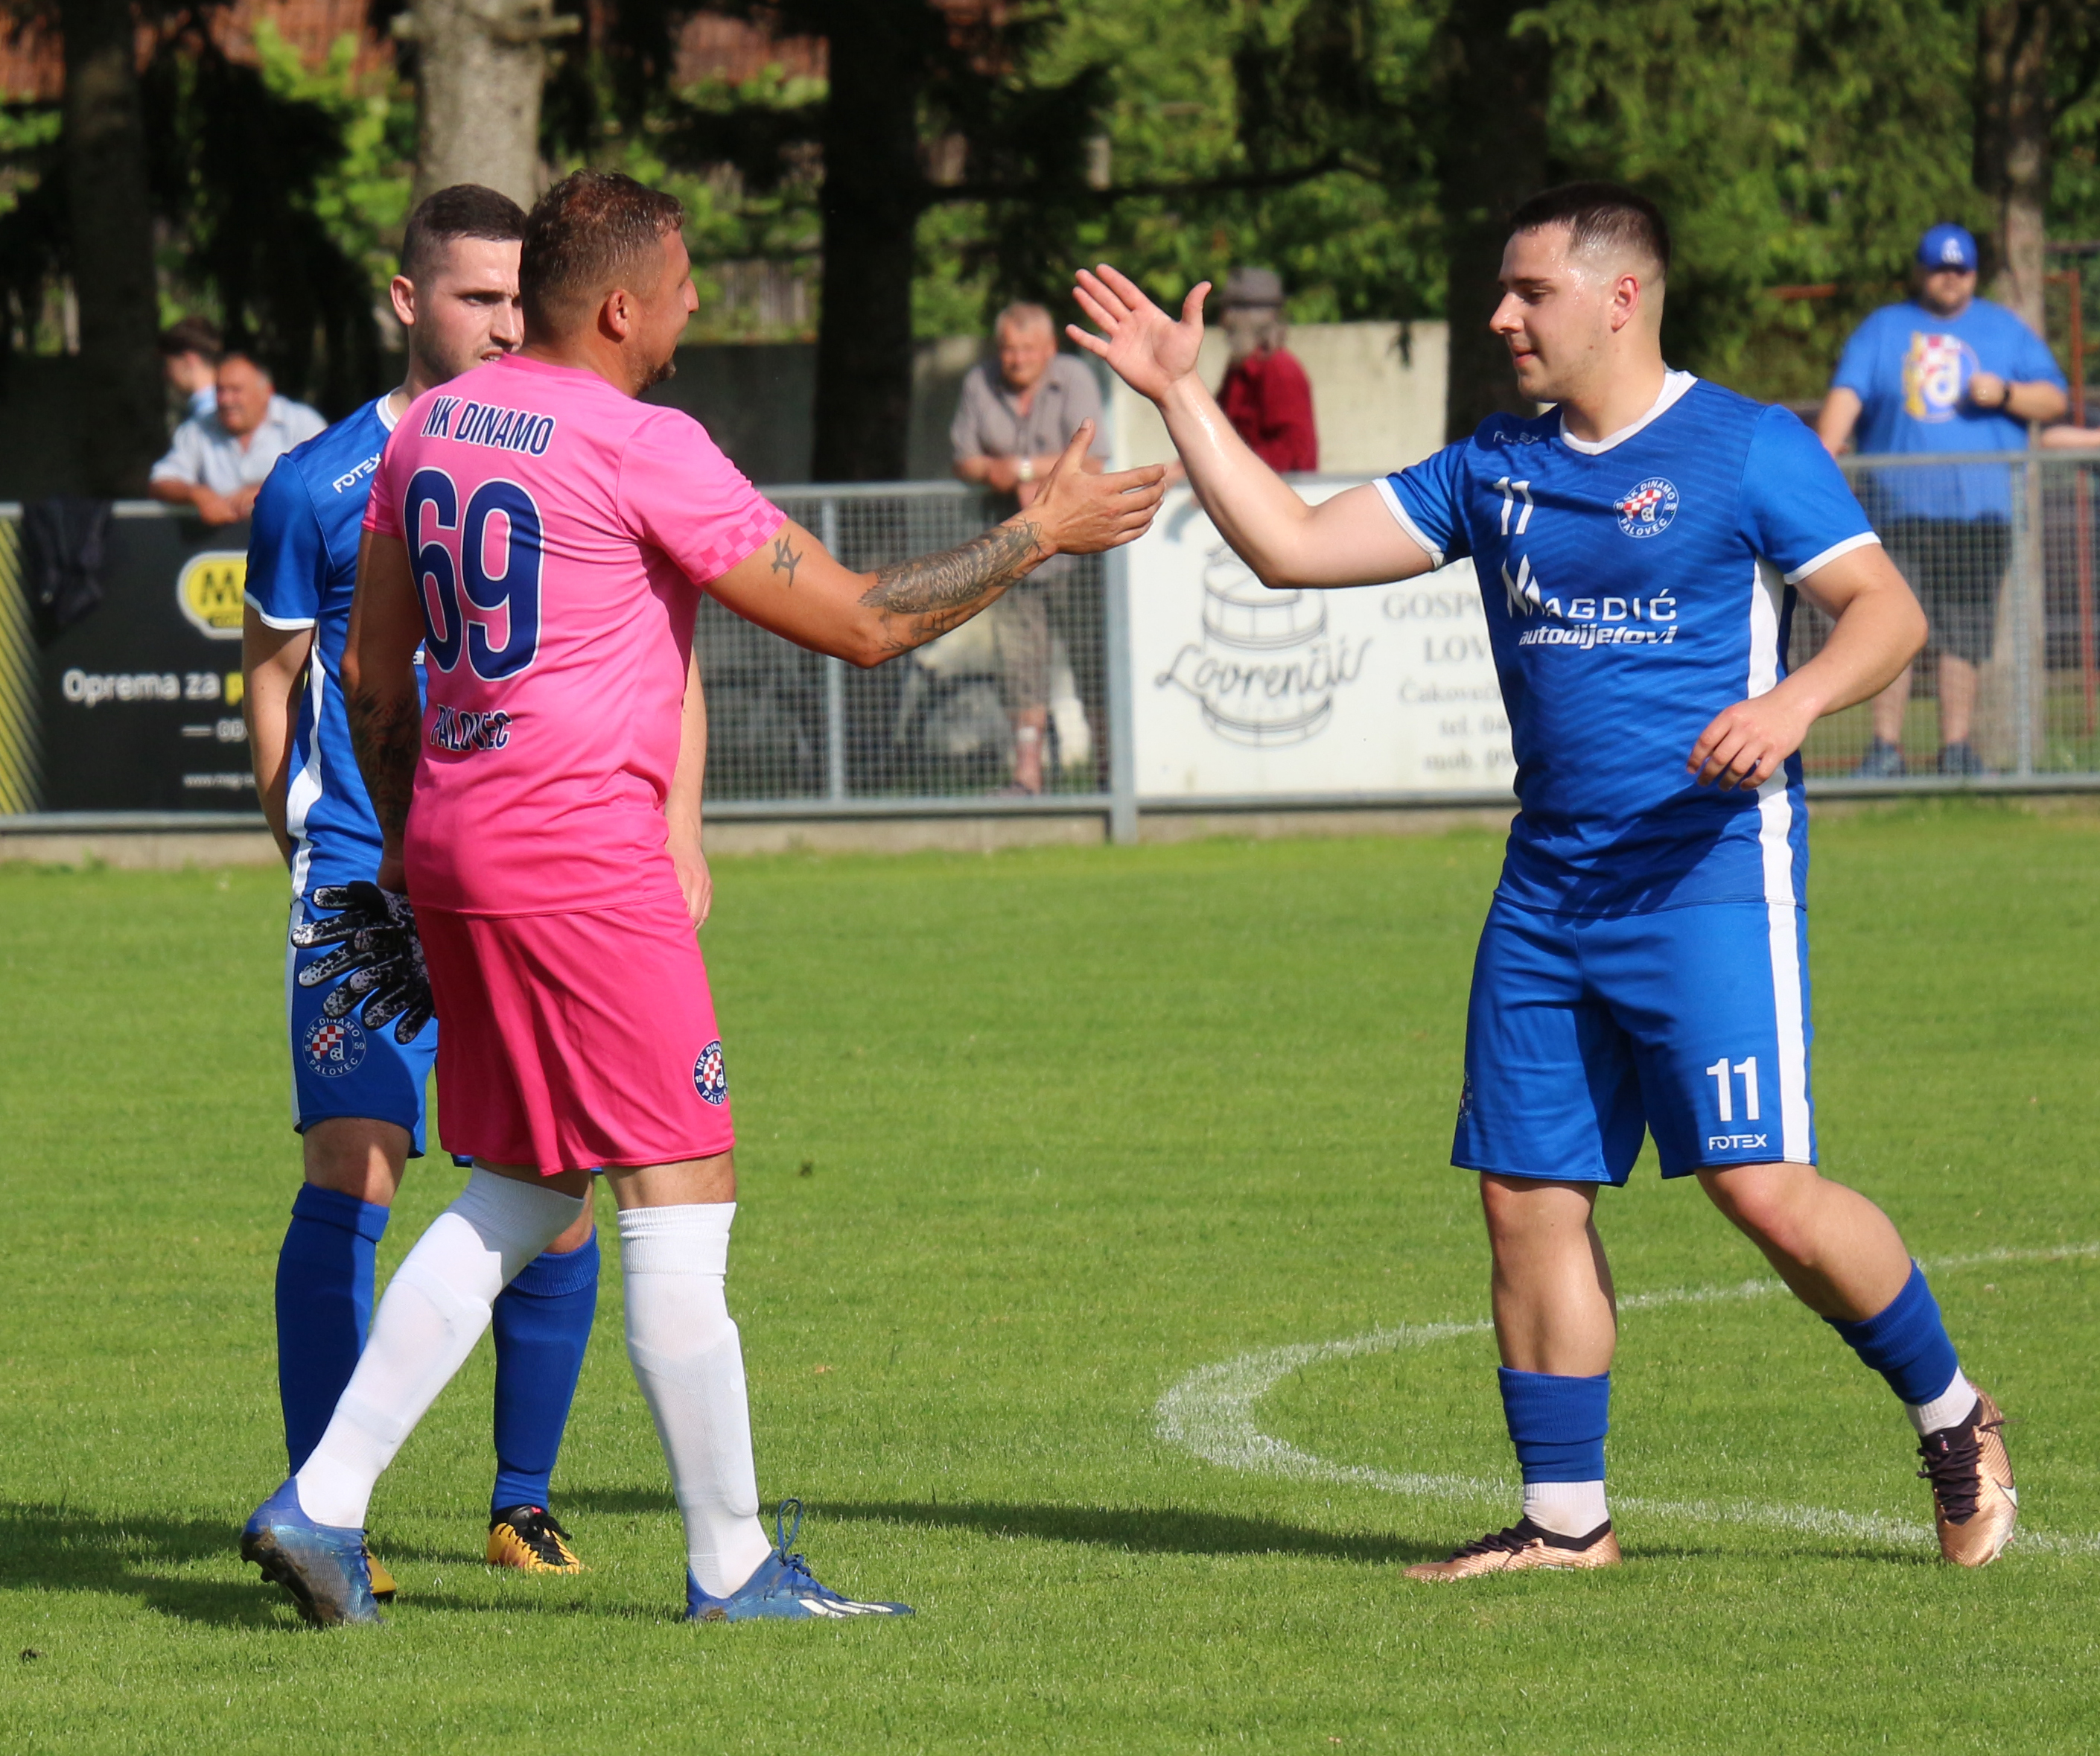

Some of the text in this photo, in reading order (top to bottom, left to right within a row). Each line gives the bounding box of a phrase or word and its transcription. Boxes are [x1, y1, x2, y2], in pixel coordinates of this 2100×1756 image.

[420, 395, 556, 457] NK DINAMO
[332, 453, 382, 494] FOTEX
[1641, 480, 1676, 500] DINAMO
[1493, 477, 1534, 535] 11
[1620, 518, 1667, 535] PALOVEC
[403, 466, 544, 681] 69
[1501, 553, 1677, 620] MAGDIĆ
[1518, 623, 1679, 650] autodijelovi
[63, 668, 180, 707] Oprema
[185, 672, 220, 700] za
[430, 704, 512, 751] PALOVEC
[306, 1017, 360, 1039] NK DINAMO
[309, 1058, 357, 1075] PALOVEC
[696, 1054, 707, 1070] NK
[696, 1075, 704, 1083] 19
[1706, 1056, 1760, 1122] 11
[1708, 1133, 1767, 1151] FOTEX
